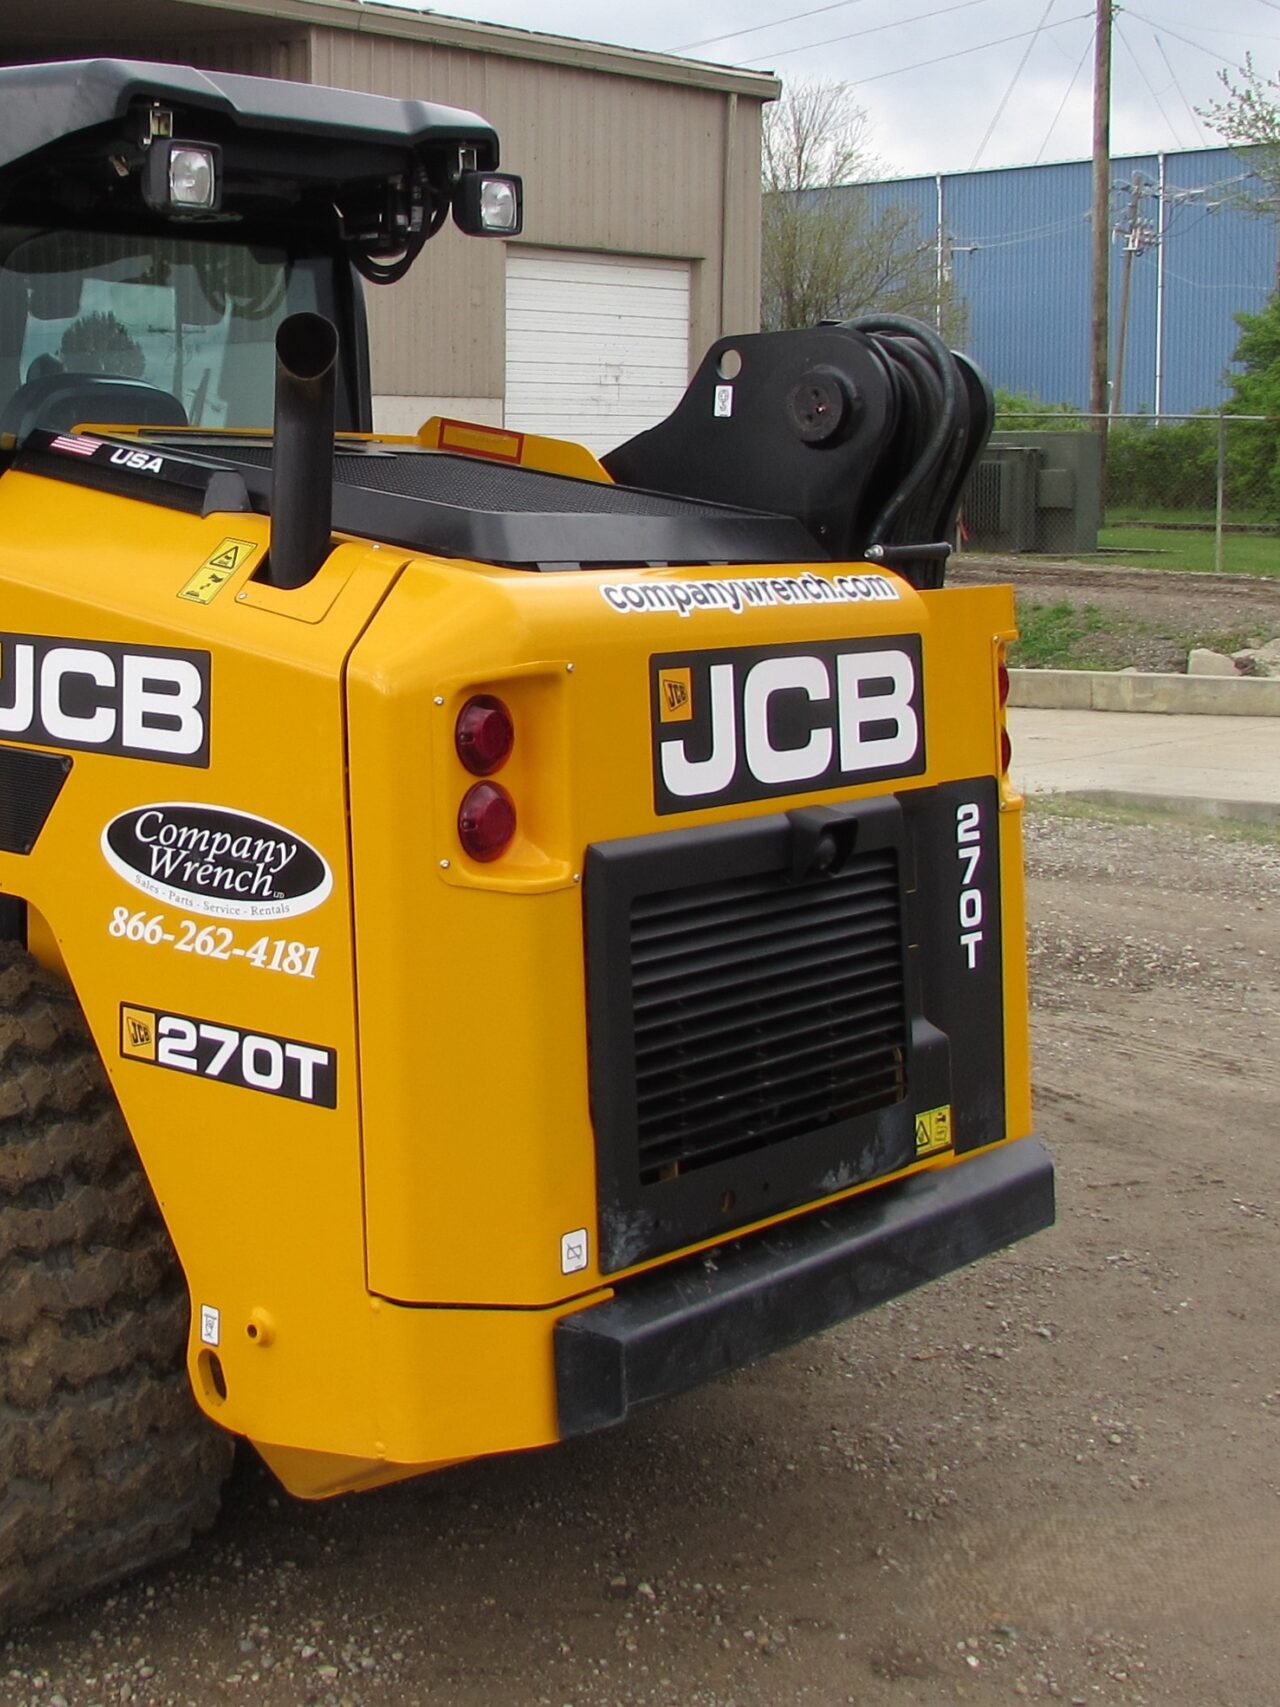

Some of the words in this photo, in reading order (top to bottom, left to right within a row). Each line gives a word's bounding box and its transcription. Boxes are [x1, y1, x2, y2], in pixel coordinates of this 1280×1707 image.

[110, 448, 163, 473] USA
[601, 572, 899, 615] companywrench.com
[661, 650, 918, 797] JCB
[666, 682, 687, 708] JCB
[135, 811, 297, 873] Company
[149, 844, 273, 897] Wrench
[135, 873, 160, 895] Sales
[168, 891, 193, 908] Parts
[203, 900, 241, 916] Service
[251, 902, 290, 916] Rentals
[956, 803, 983, 969] 270T
[109, 906, 320, 979] 866-262-4181
[130, 1021, 152, 1044] JCB
[158, 1015, 329, 1100] 270T
